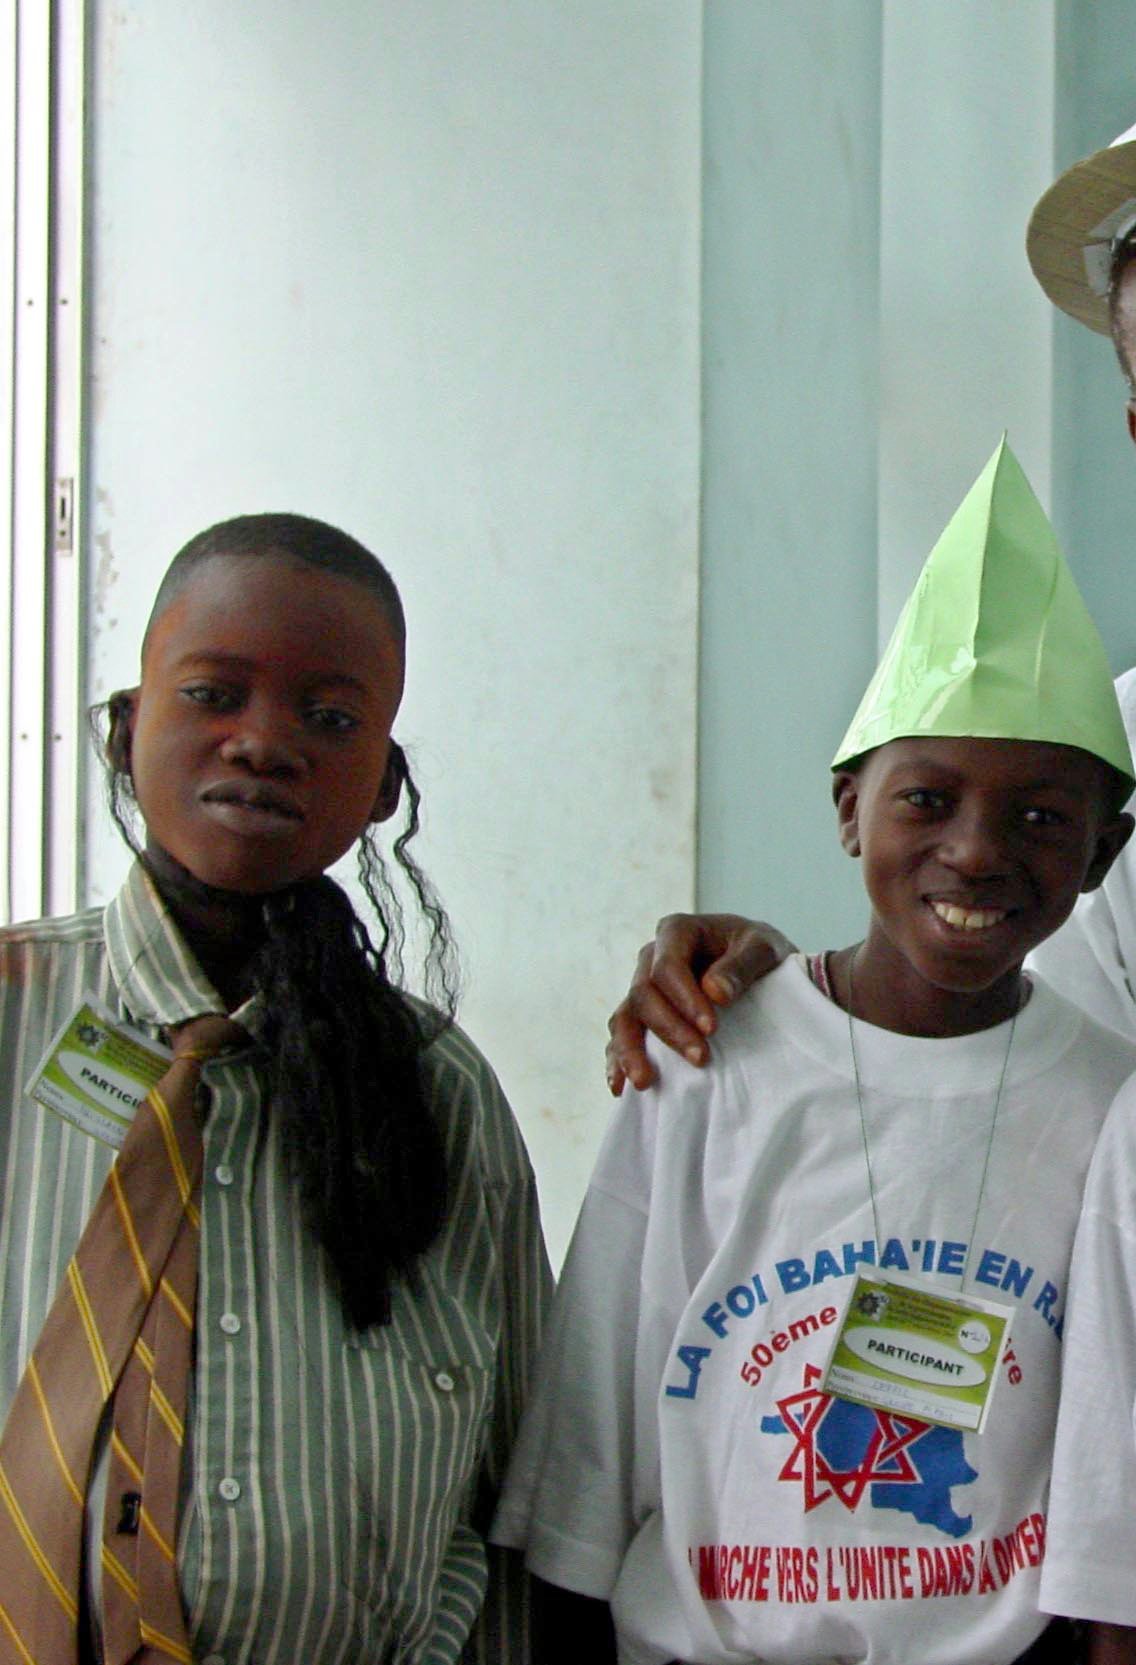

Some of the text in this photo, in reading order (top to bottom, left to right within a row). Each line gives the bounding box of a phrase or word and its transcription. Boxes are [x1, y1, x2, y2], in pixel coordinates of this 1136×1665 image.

[665, 1345, 712, 1399] LA
[702, 1274, 768, 1339] FOI
[776, 1238, 968, 1294] BAHA'IE
[975, 1249, 1034, 1299] EN
[867, 1339, 964, 1376] PARTICIPANT
[776, 1546, 819, 1603] VERS
[827, 1546, 914, 1602] L'UNITE
[916, 1543, 976, 1599] DANS
